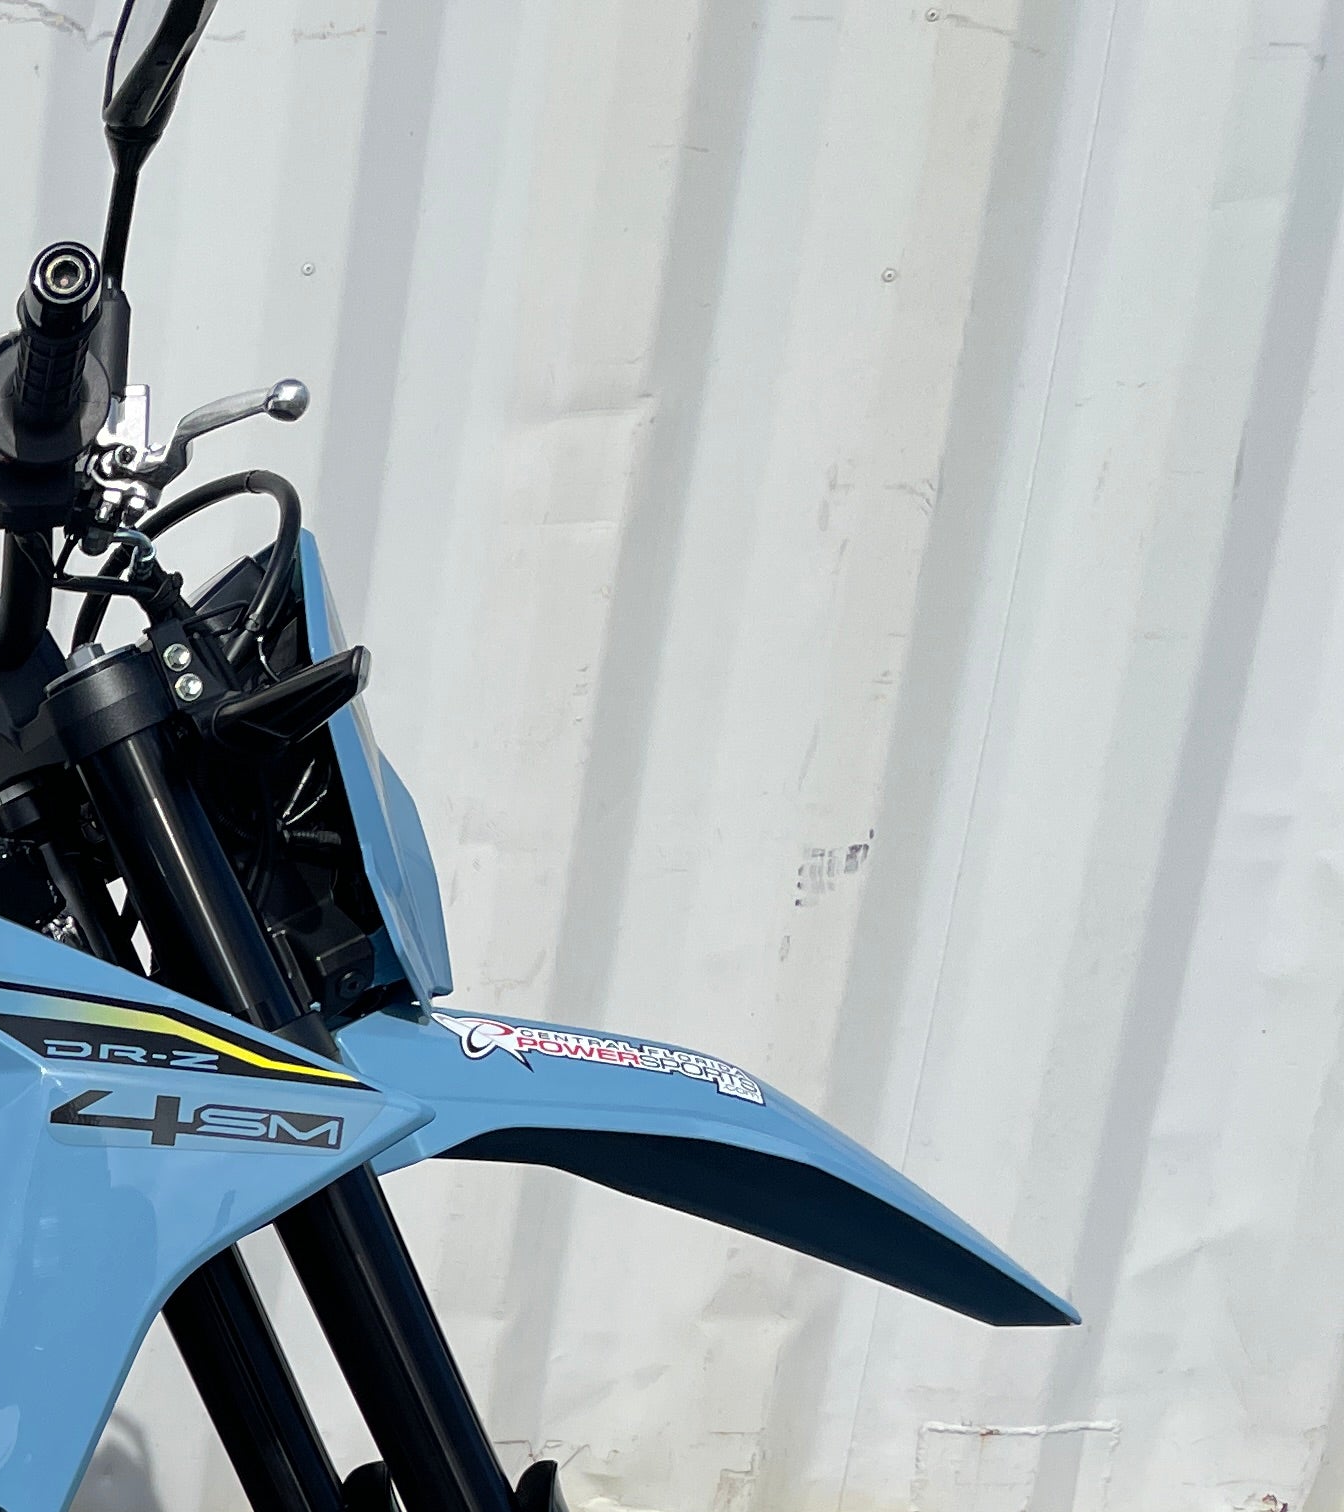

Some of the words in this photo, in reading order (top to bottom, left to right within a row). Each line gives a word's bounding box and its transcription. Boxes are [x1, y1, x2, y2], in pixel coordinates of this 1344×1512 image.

[43, 1038, 219, 1070] DR-Z
[517, 1036, 758, 1094] POWERSPORTS
[520, 1029, 630, 1051] CENTRAL
[644, 1045, 748, 1077] FLORIDA
[50, 1090, 344, 1150] 4SM
